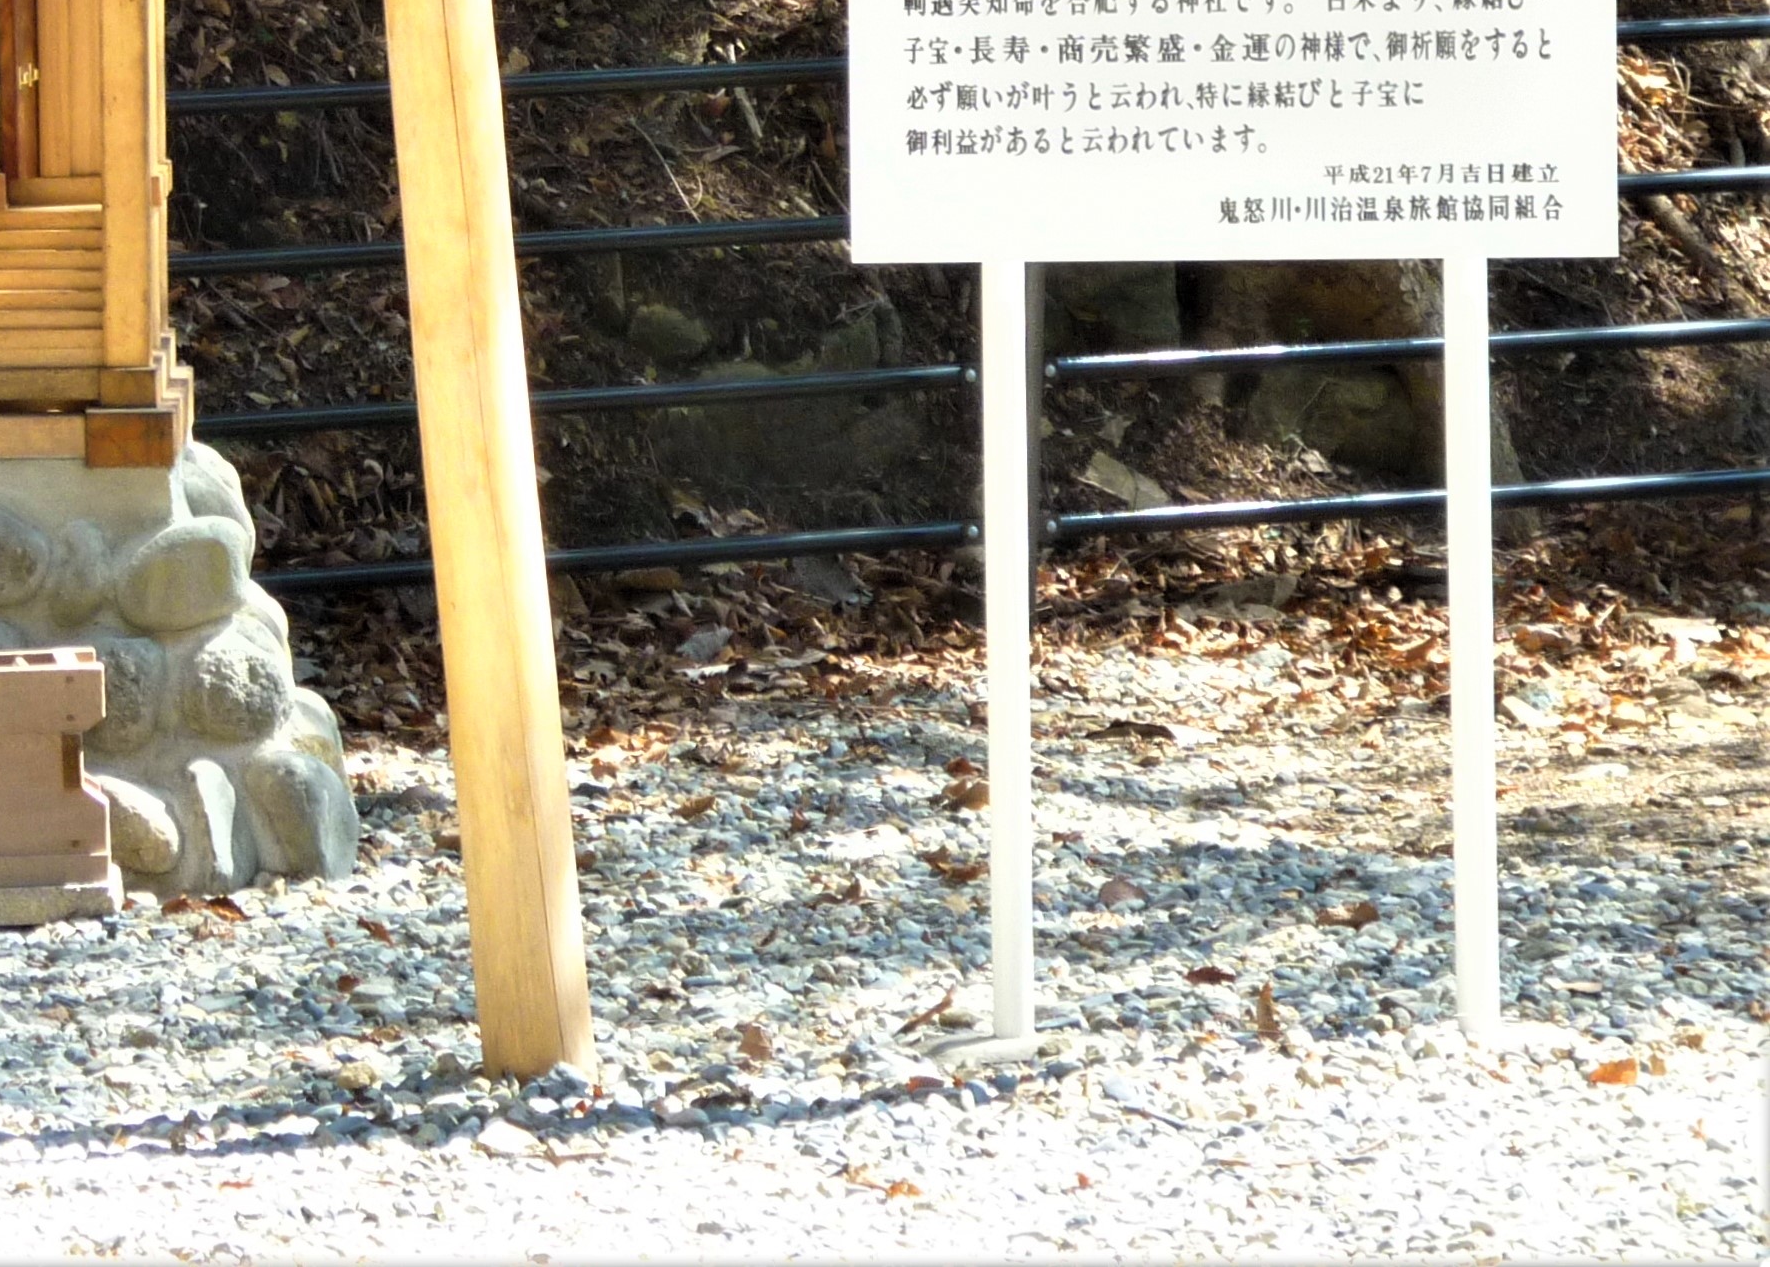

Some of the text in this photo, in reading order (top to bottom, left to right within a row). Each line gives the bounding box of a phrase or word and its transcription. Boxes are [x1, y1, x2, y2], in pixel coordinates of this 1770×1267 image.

[906, 124, 1265, 156] 御利益があると云われています。
[1324, 162, 1559, 185] 平成21年7月吉日建立
[1218, 194, 1563, 224] 鬼怒川・川治温泉旅館協同組合
